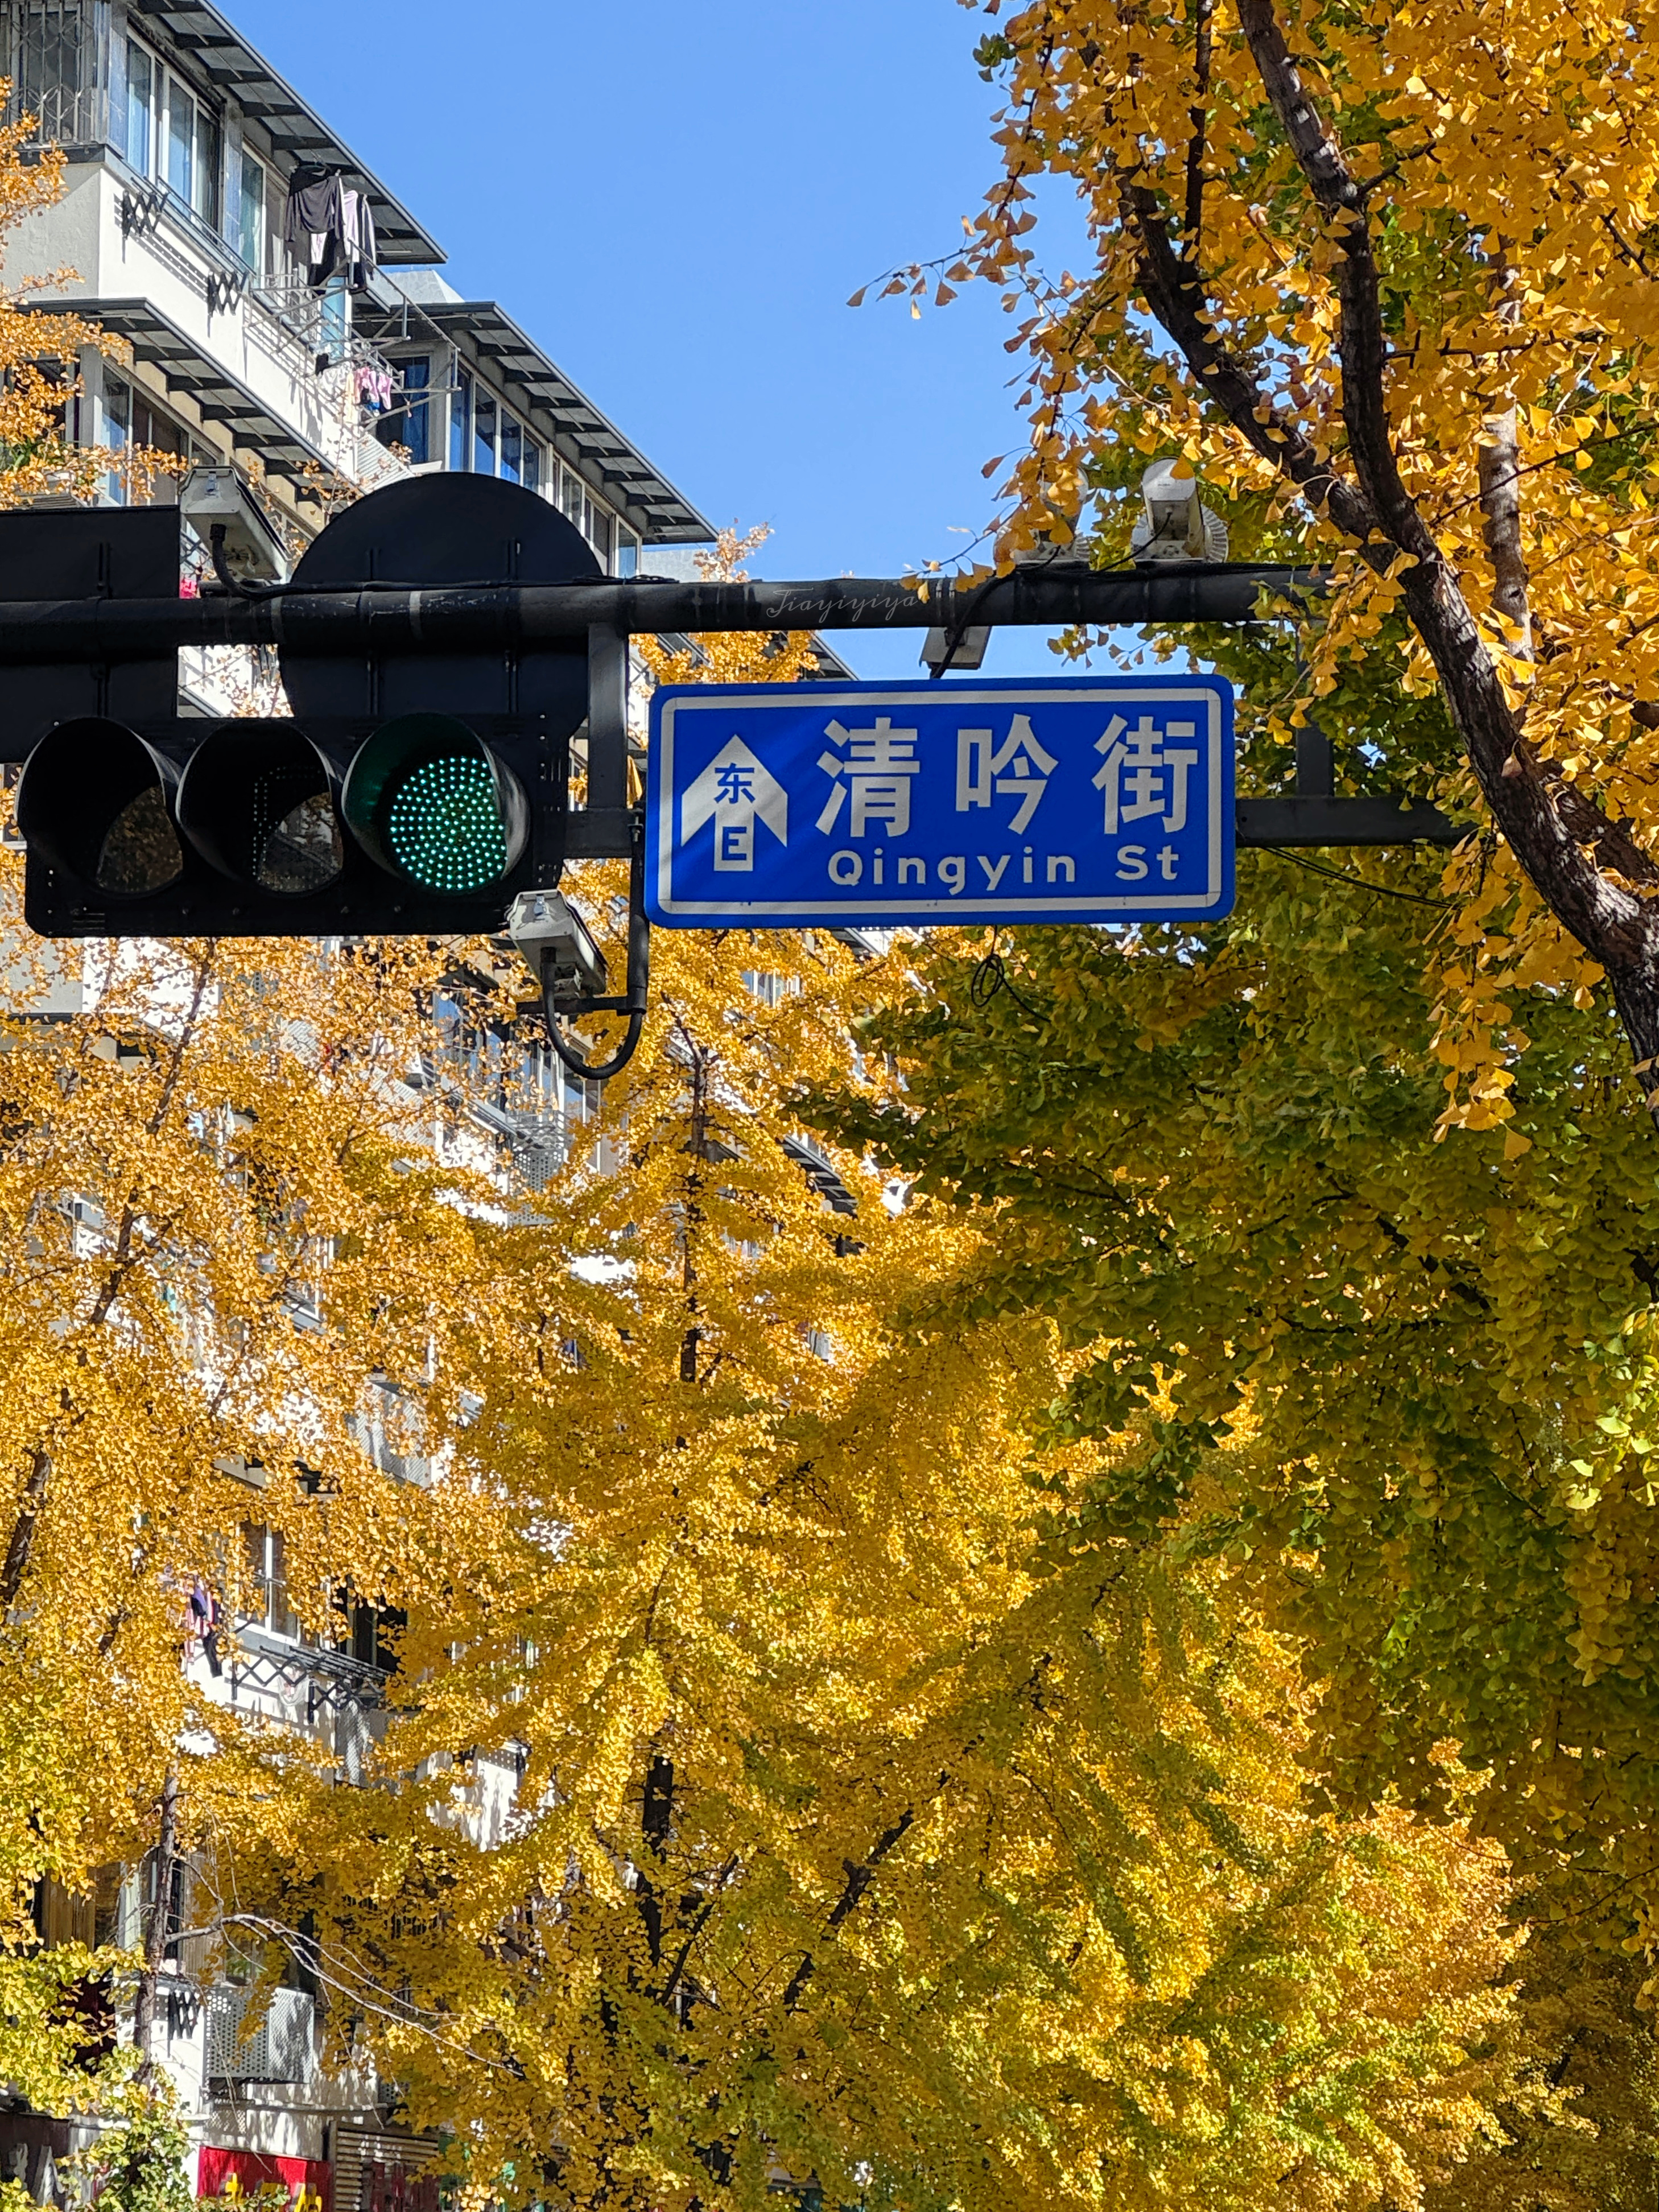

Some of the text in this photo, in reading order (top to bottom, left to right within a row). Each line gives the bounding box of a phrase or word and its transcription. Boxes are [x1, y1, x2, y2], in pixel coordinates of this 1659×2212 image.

[714, 762, 756, 804] 东
[816, 713, 1198, 837] 清吟街
[721, 826, 748, 861] E
[828, 845, 1179, 895] Qingyin St
